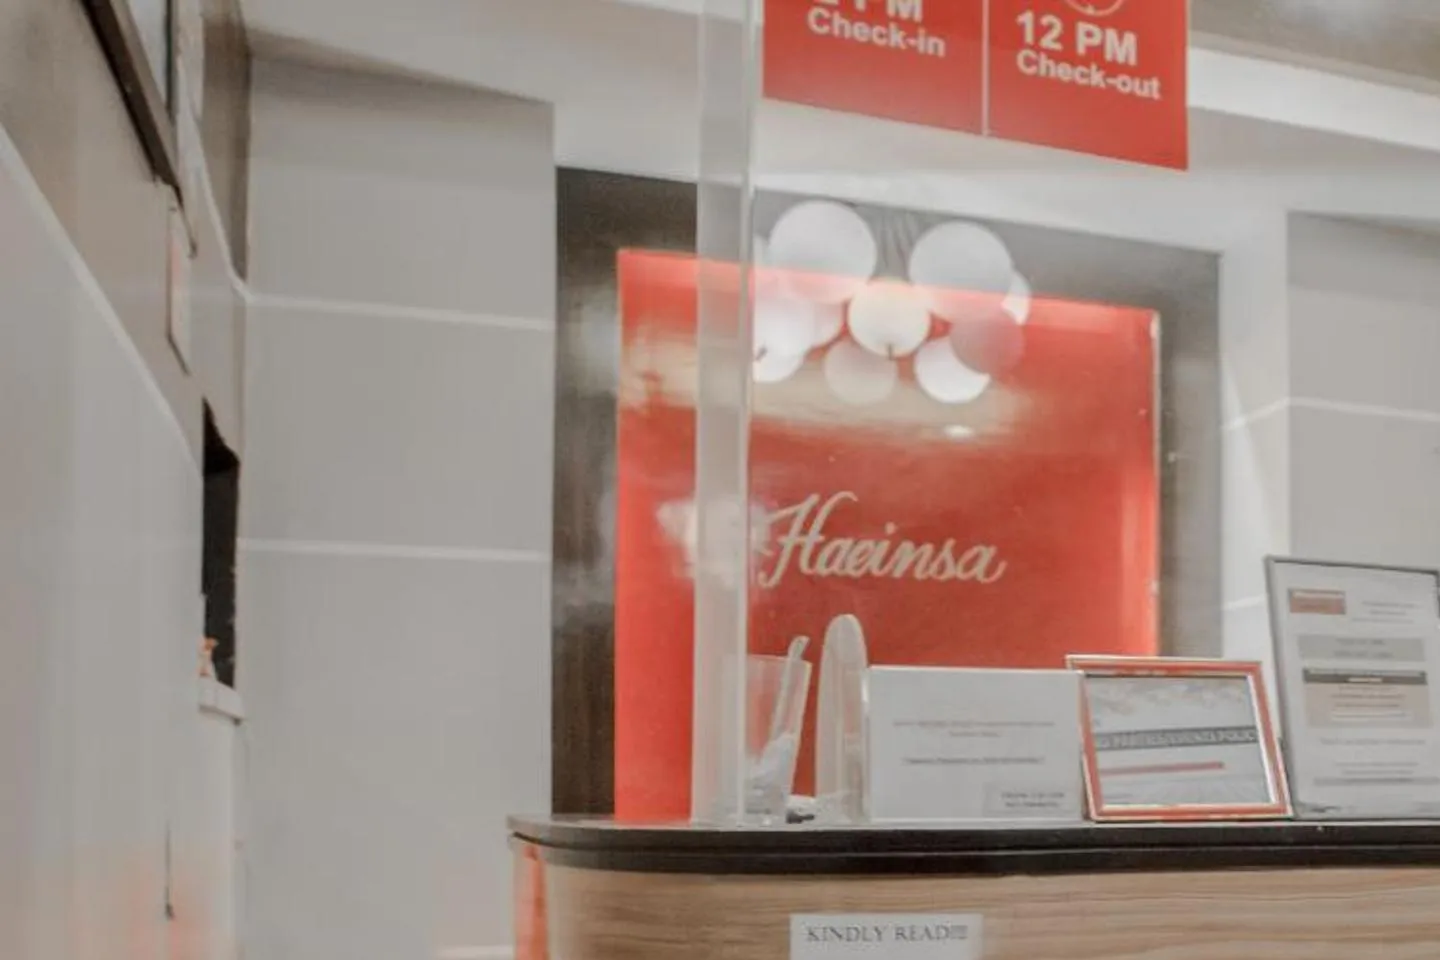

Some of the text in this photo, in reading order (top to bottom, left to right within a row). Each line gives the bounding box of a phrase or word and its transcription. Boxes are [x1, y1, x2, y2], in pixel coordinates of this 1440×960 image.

[808, 6, 946, 58] Check-in
[1016, 10, 1138, 66] 12 PM
[1016, 49, 1162, 100] Check-out
[758, 491, 1008, 588] Haeinsa
[806, 926, 888, 942] KINDLY
